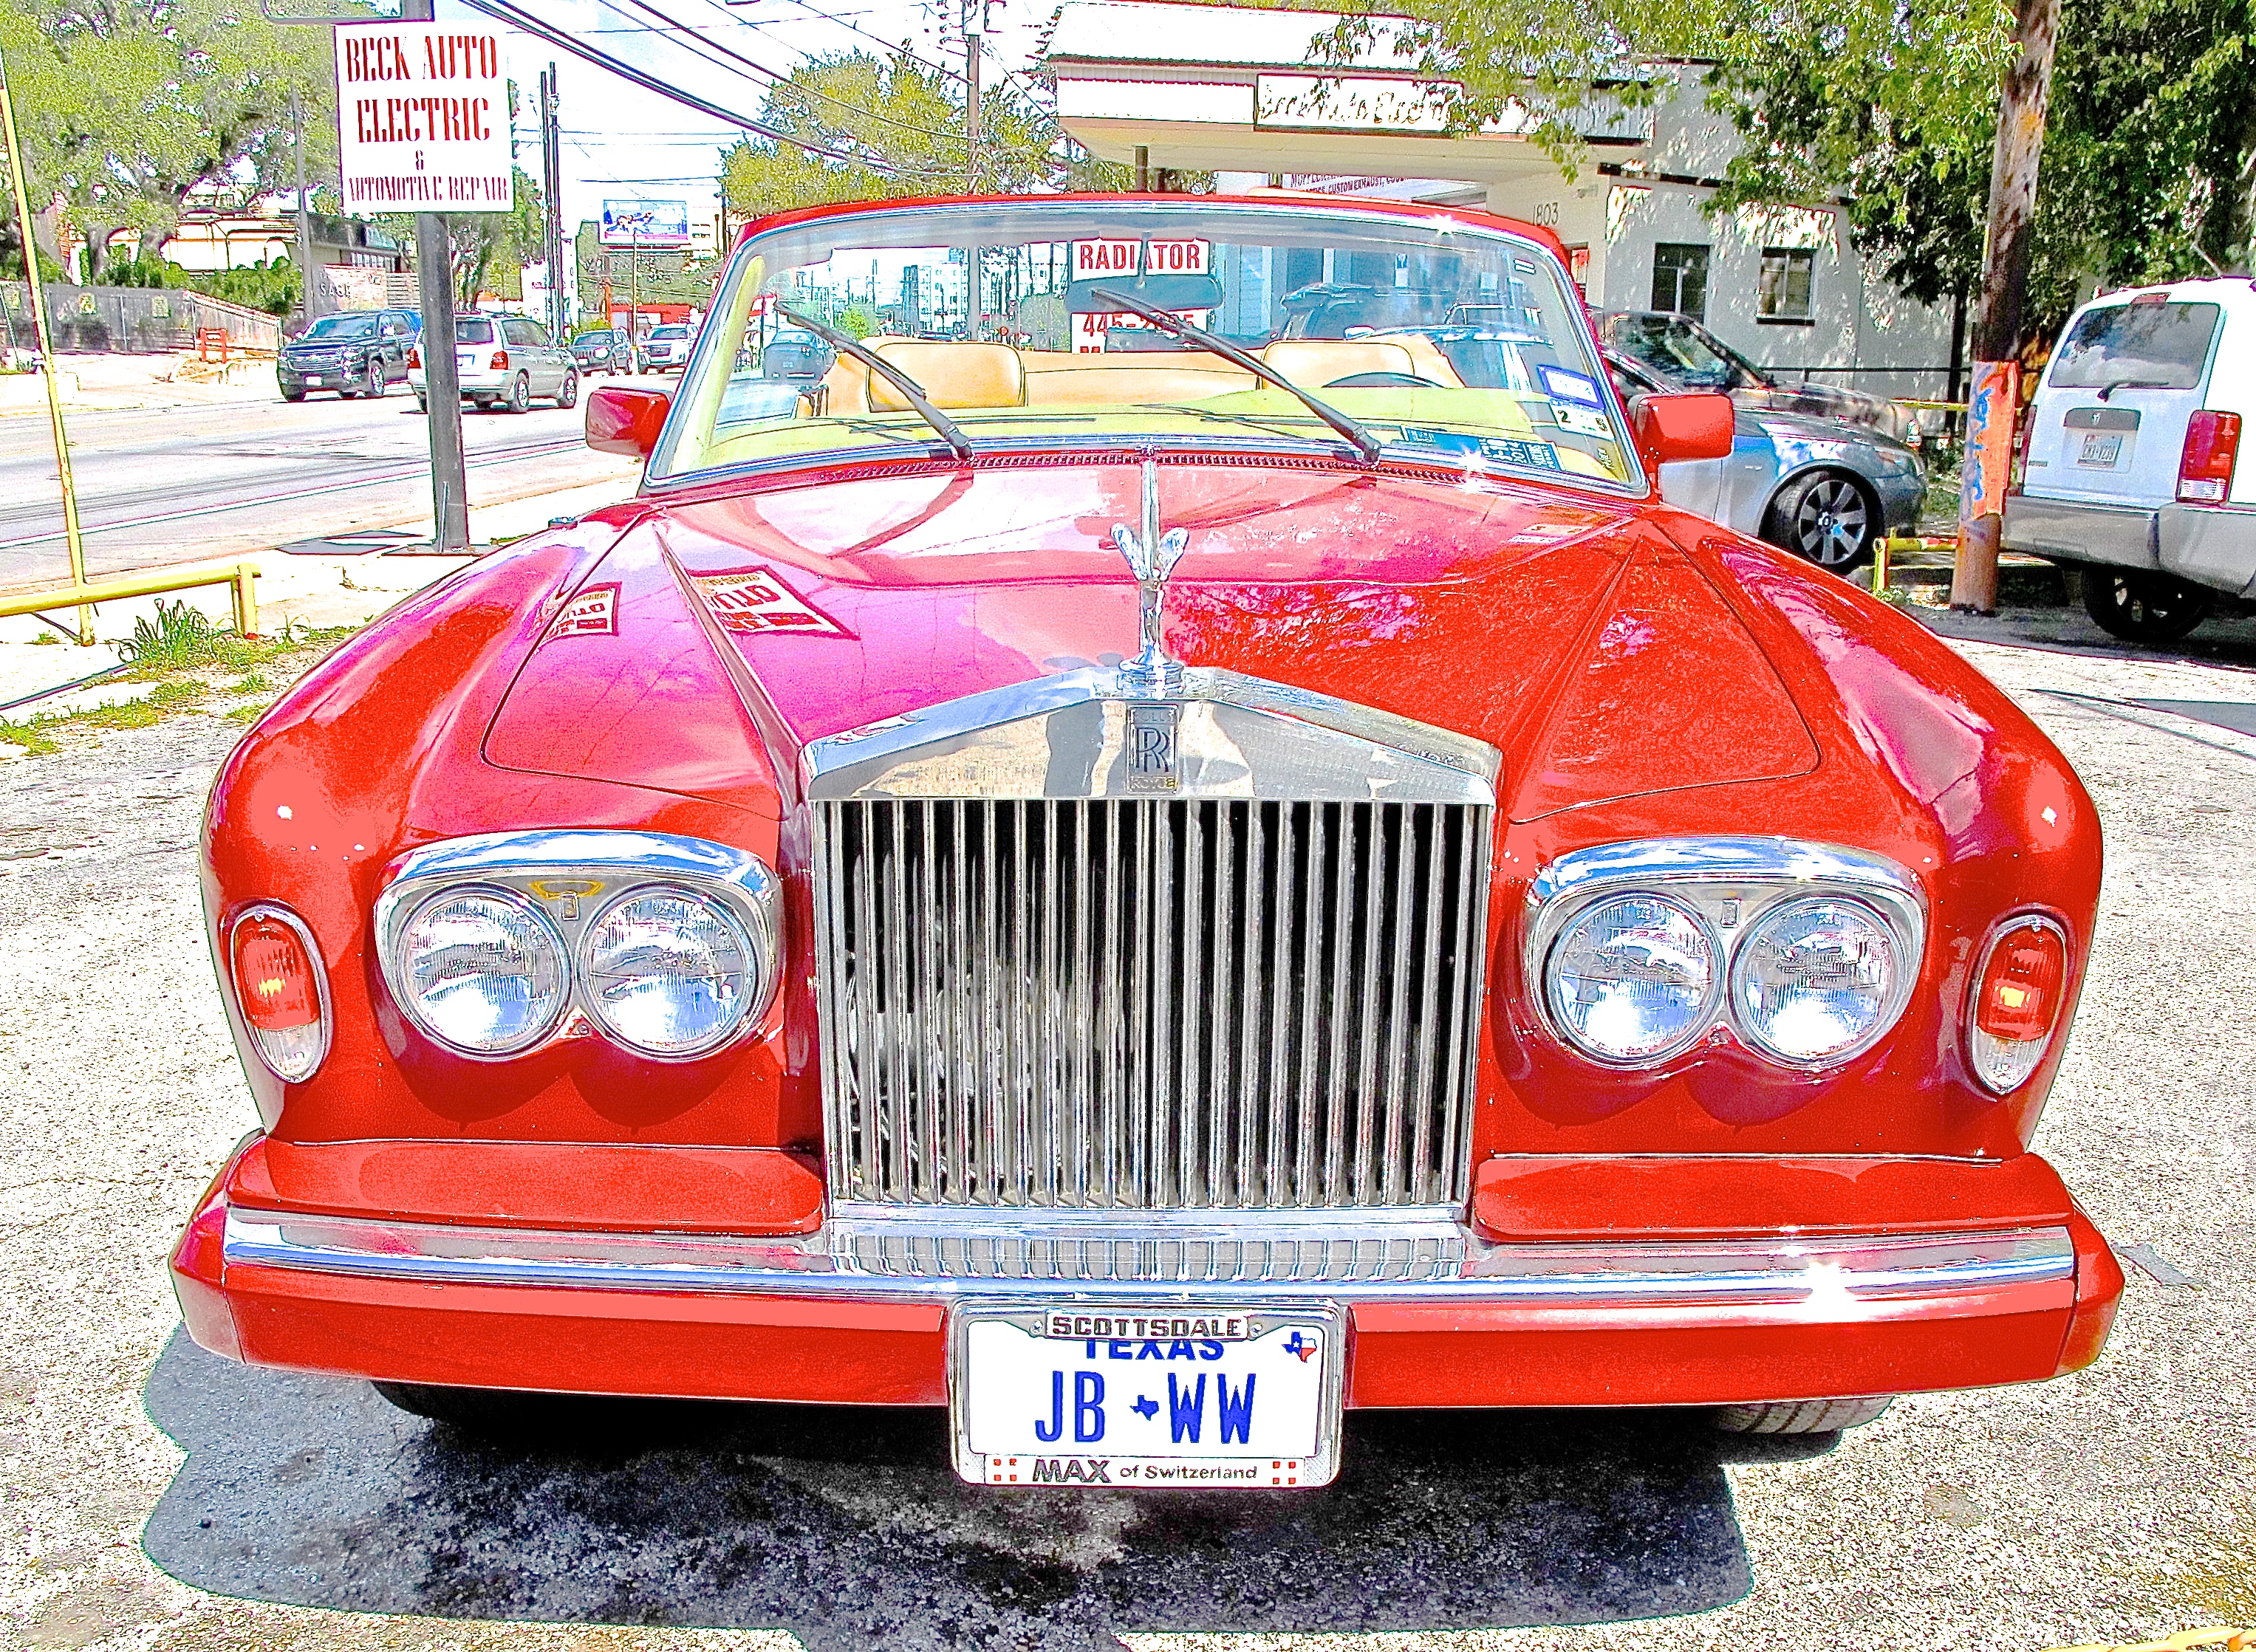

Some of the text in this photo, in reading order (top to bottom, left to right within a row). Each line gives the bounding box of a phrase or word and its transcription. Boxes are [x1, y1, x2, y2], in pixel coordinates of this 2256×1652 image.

[346, 35, 497, 82] BECK AUTO
[357, 97, 490, 143] ELECTRIC
[415, 149, 424, 171] &
[349, 176, 507, 202] AUTOMOTIVE REPAIR
[1532, 202, 1559, 226] 1803
[1080, 244, 1200, 270] RADIATOR
[1133, 709, 1175, 722] OLLS
[1053, 1316, 1242, 1337] SCOTTSDALE
[1086, 1339, 1225, 1361] TEXAS
[1035, 1371, 1257, 1444] JB WW
[1032, 1459, 1257, 1484] MAX of Switzerland
